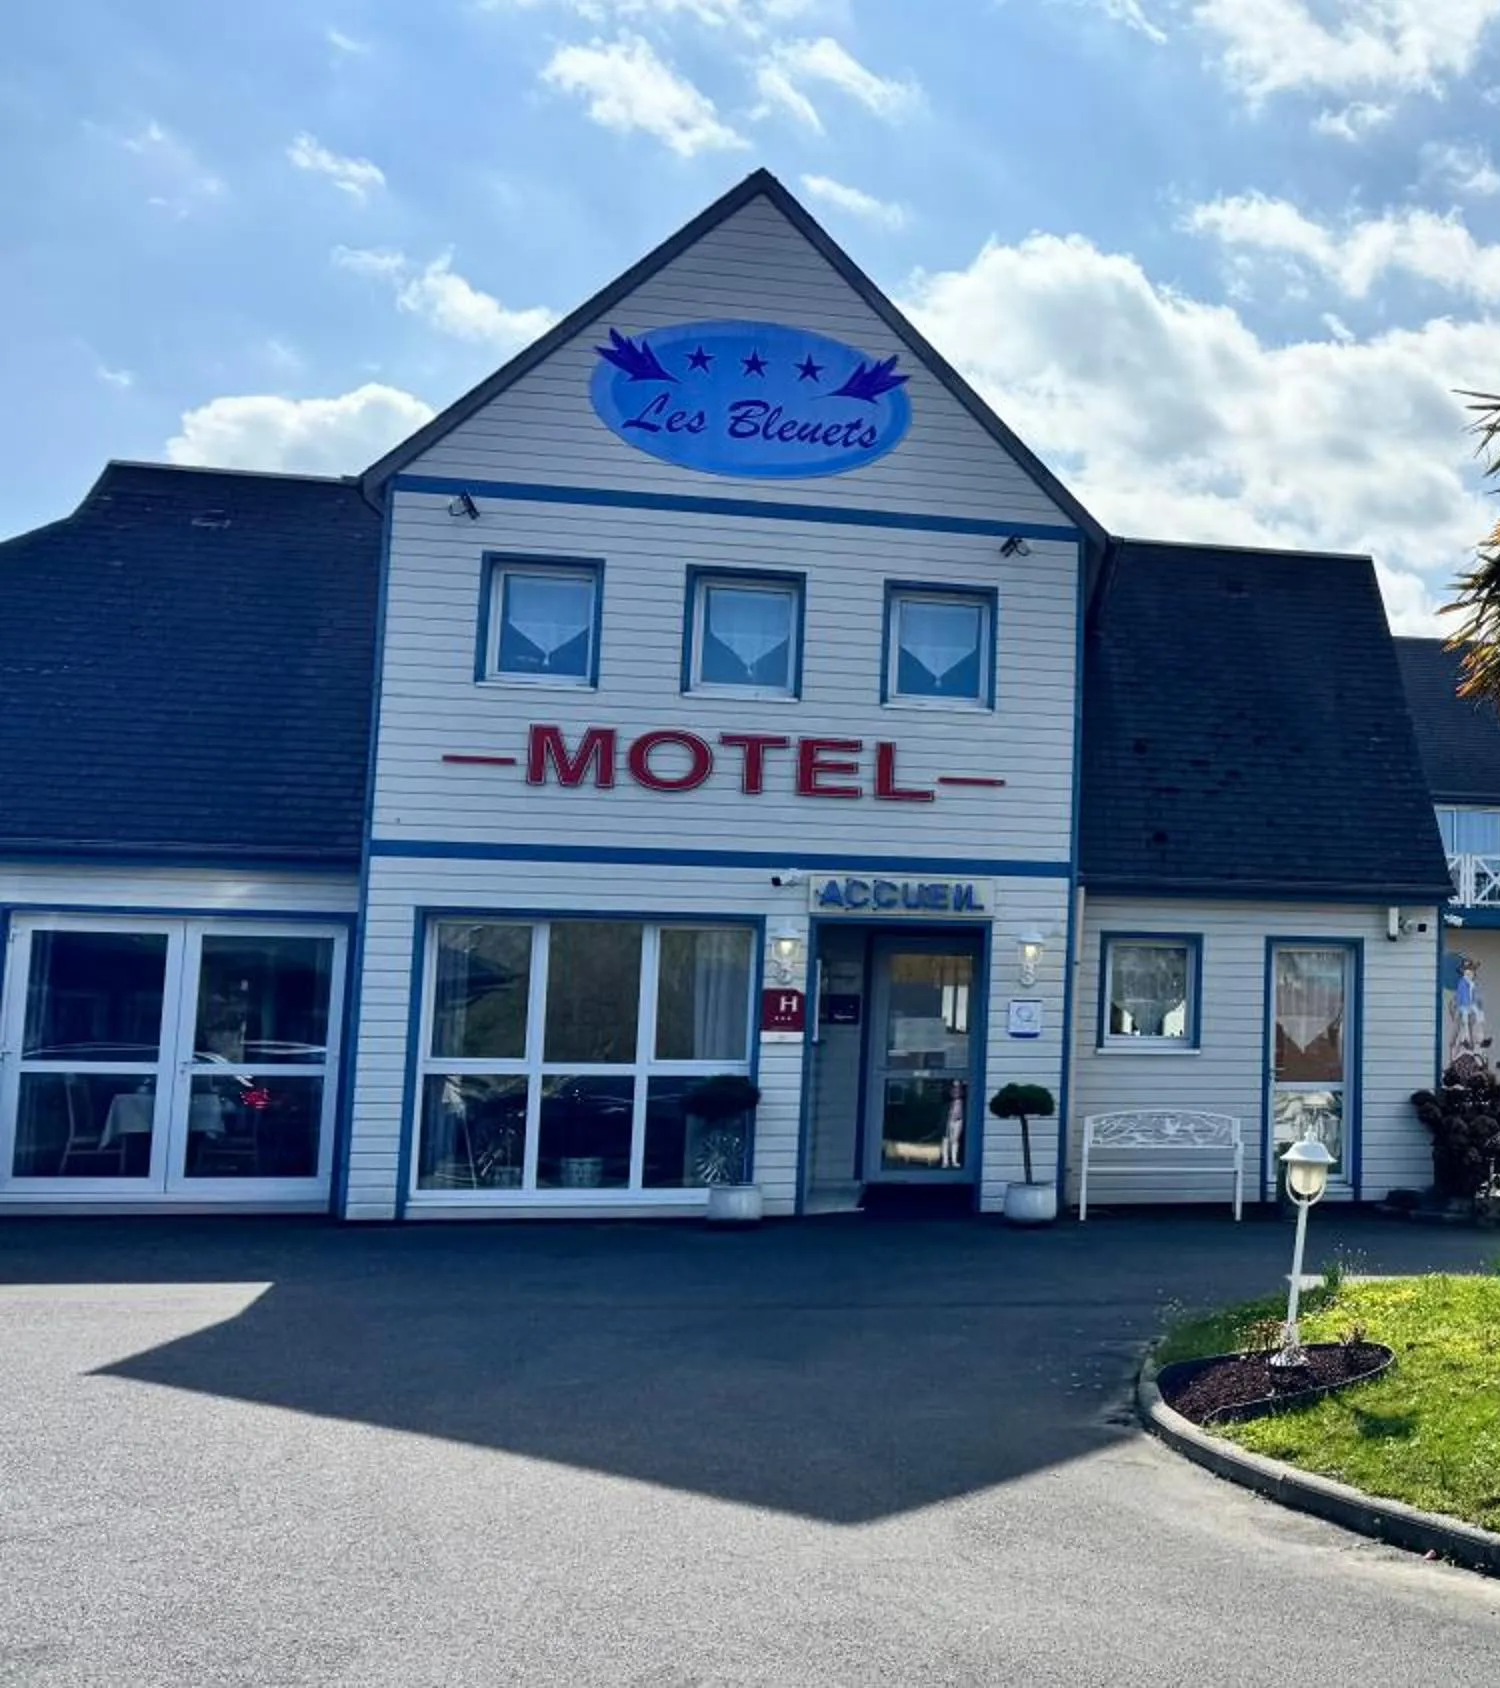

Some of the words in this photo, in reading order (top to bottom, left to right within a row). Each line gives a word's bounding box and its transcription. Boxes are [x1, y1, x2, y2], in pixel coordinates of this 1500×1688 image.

[622, 392, 706, 433] Les
[727, 399, 881, 449] Bleuets
[525, 723, 936, 802] MOTEL
[817, 877, 985, 912] ACCUEIL
[780, 995, 798, 1013] H
